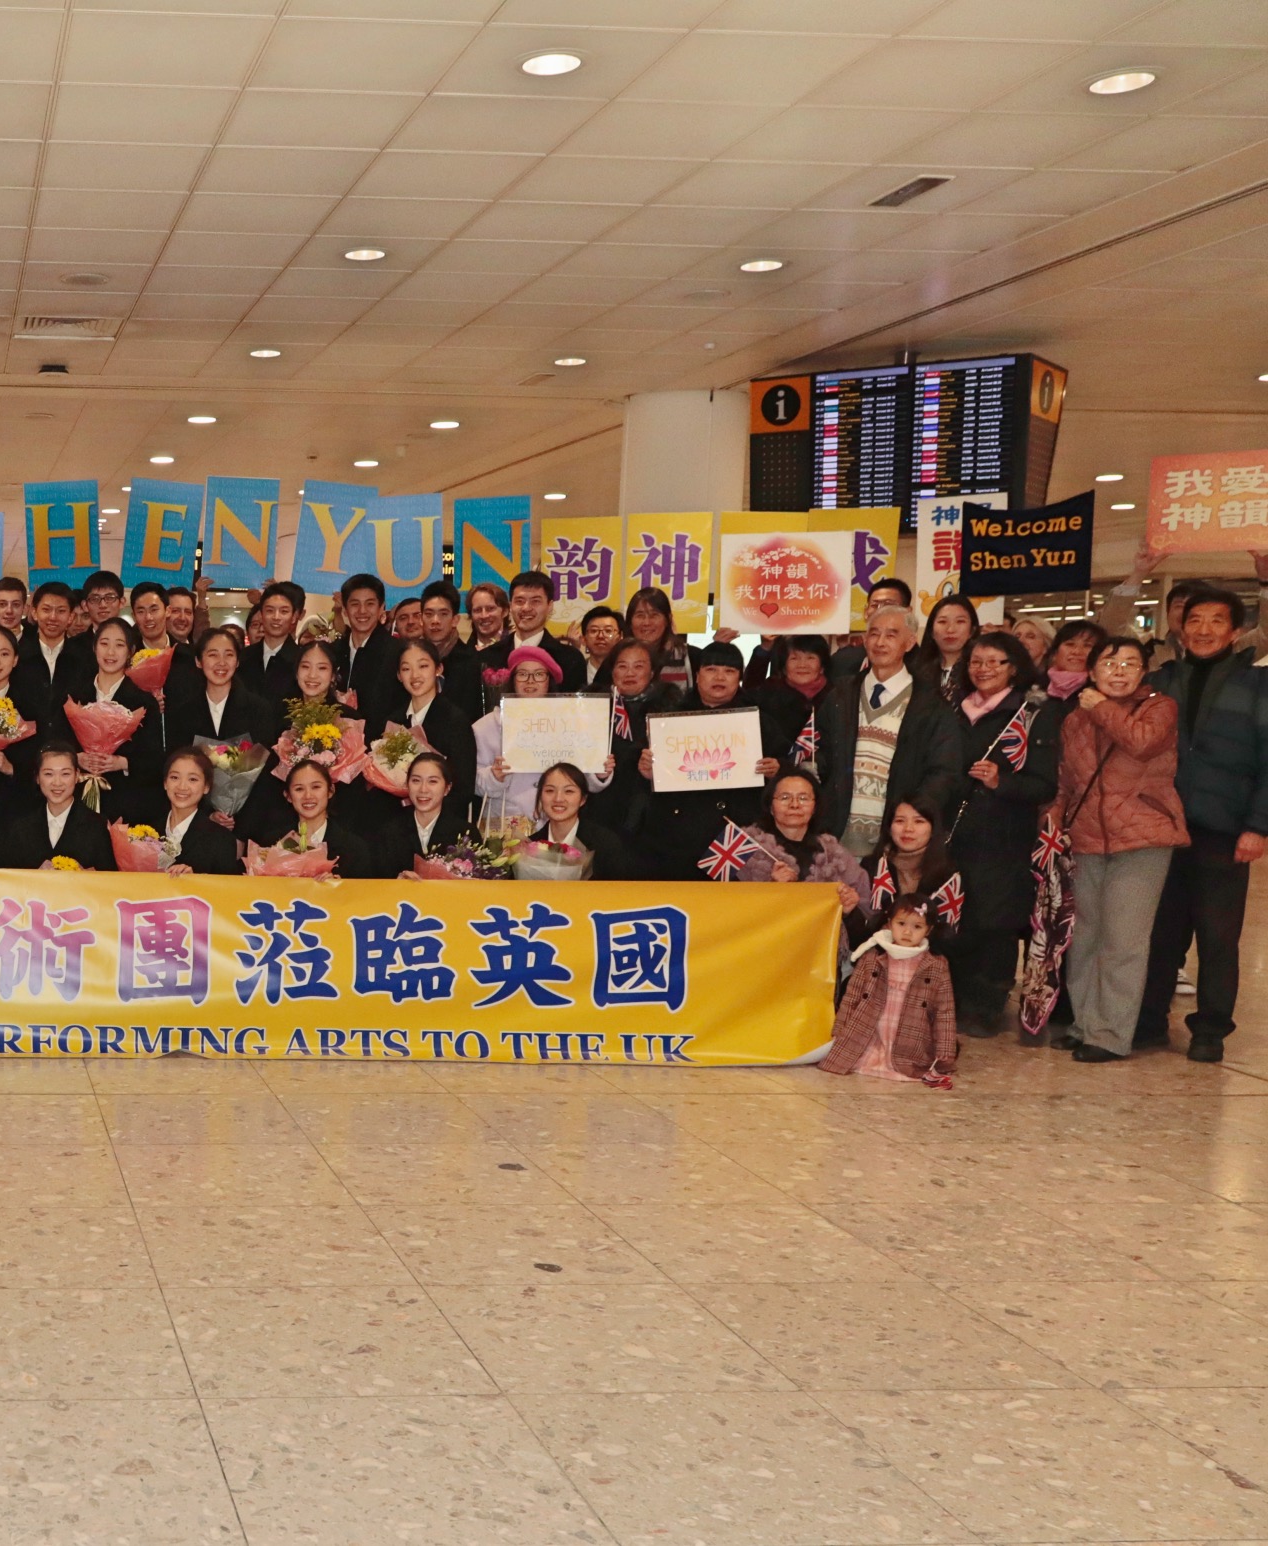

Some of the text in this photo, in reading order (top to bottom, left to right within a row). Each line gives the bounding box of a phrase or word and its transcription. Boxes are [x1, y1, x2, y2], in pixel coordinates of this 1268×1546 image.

[969, 515, 1082, 538] Welcome
[545, 536, 615, 602] 韵
[630, 532, 703, 602] 神
[970, 548, 1077, 572] Shen Yun
[761, 563, 808, 580] 神韻
[742, 606, 758, 617] We
[522, 718, 556, 733] SHEN
[532, 749, 575, 758] welcome
[665, 732, 747, 754] SHEN YUN
[282, 1028, 412, 1058] ARTS
[421, 1030, 491, 1059] TO
[500, 1031, 610, 1061] THE
[618, 1034, 700, 1063] UK
